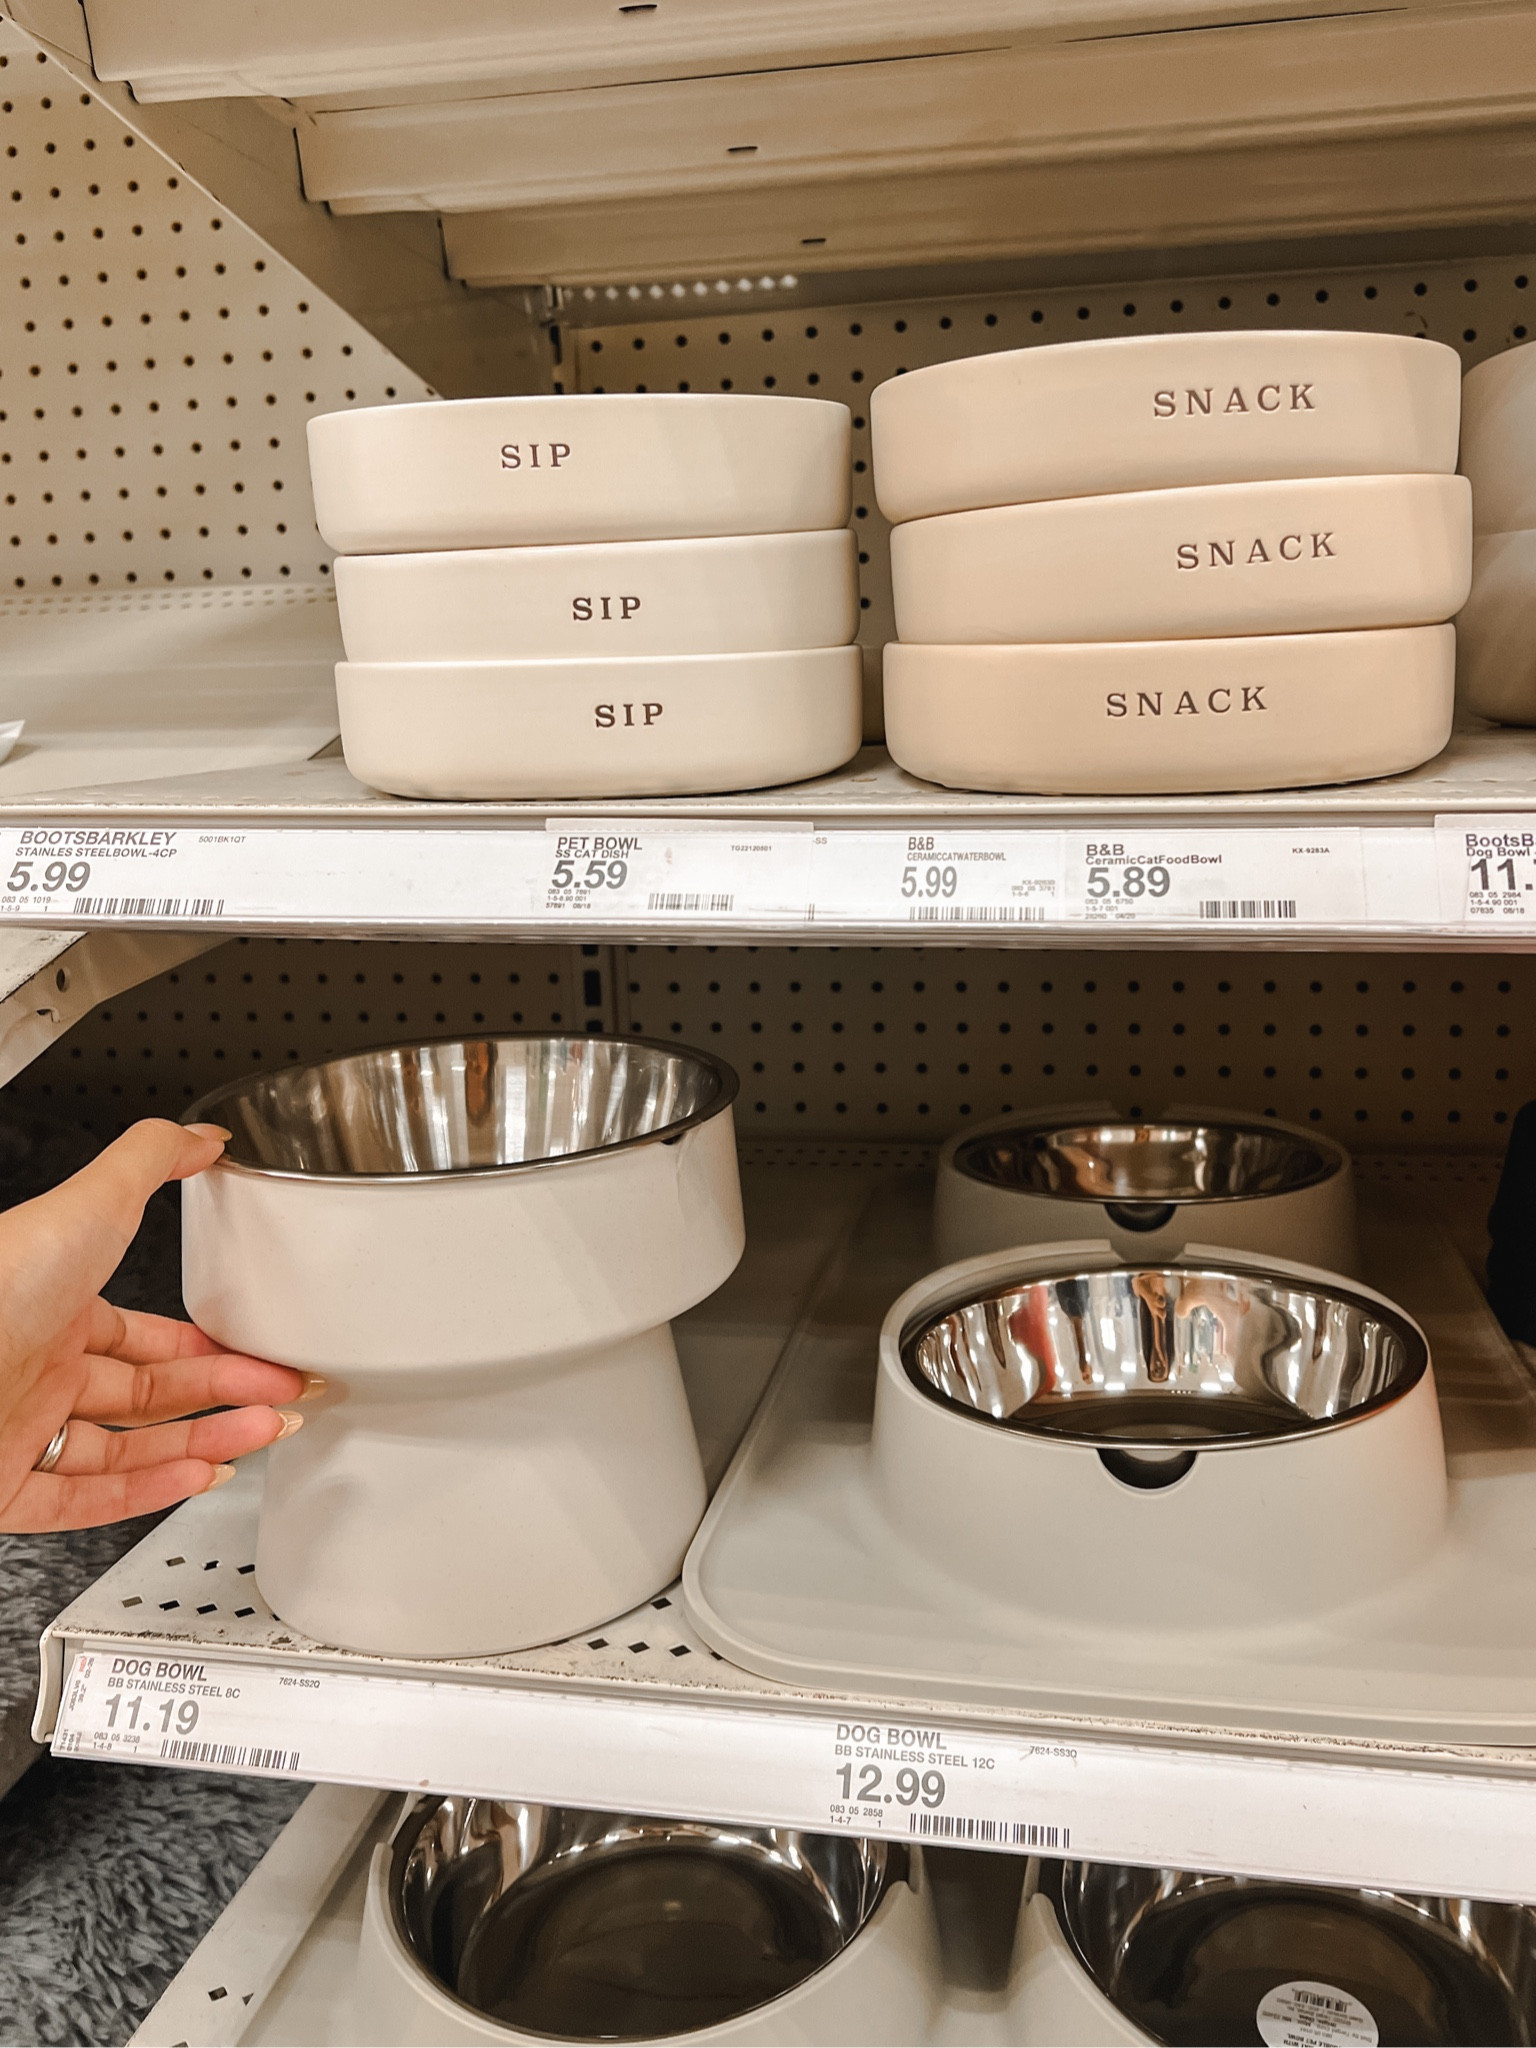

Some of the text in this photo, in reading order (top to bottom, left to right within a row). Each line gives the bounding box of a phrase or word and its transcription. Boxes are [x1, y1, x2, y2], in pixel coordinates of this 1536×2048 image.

[1153, 383, 1315, 417] SNACK
[500, 442, 573, 470] SIP
[1177, 531, 1336, 570] SNACK
[572, 596, 642, 622] SIP
[1106, 686, 1268, 718] SNACK
[594, 702, 664, 729] SIP
[20, 830, 177, 846] BOOTSBARKLEY
[557, 837, 643, 850] PET BOWL
[908, 836, 935, 851] B&B
[1465, 833, 1536, 847] BootsB
[16, 847, 177, 858] STAINLES STEELBOWL-4CP
[555, 849, 629, 859] SS CAT DISH
[907, 852, 1006, 861] CERAMICCATWATERBOWL
[1085, 854, 1222, 865] CeramicCatFoodBowl
[1086, 844, 1125, 856] B&B
[1466, 846, 1530, 859] Dog Bowl
[7, 861, 91, 892] 5.99
[551, 860, 628, 890] 5.59
[901, 866, 958, 898] 5.99
[1087, 866, 1170, 898] 5.89
[1471, 858, 1536, 891] 11.
[33, 896, 51, 904] 1019
[111, 1658, 152, 1676] DOG
[155, 1662, 208, 1682] BOWL
[108, 1677, 241, 1699] BB STAINLESS STEEL 8C
[279, 1677, 320, 1688] 7624-SS2Q
[105, 1693, 199, 1735] 11.19
[94, 1731, 108, 1740] 083
[111, 1733, 120, 1741] 05
[836, 1723, 947, 1750] DOG BOWL
[835, 1744, 995, 1769] BB STAINLESS STEEL 12C
[836, 1762, 946, 1809] 12.99
[830, 1804, 883, 1817] 083 05 2858
[830, 1815, 851, 1824] 1-4-7
